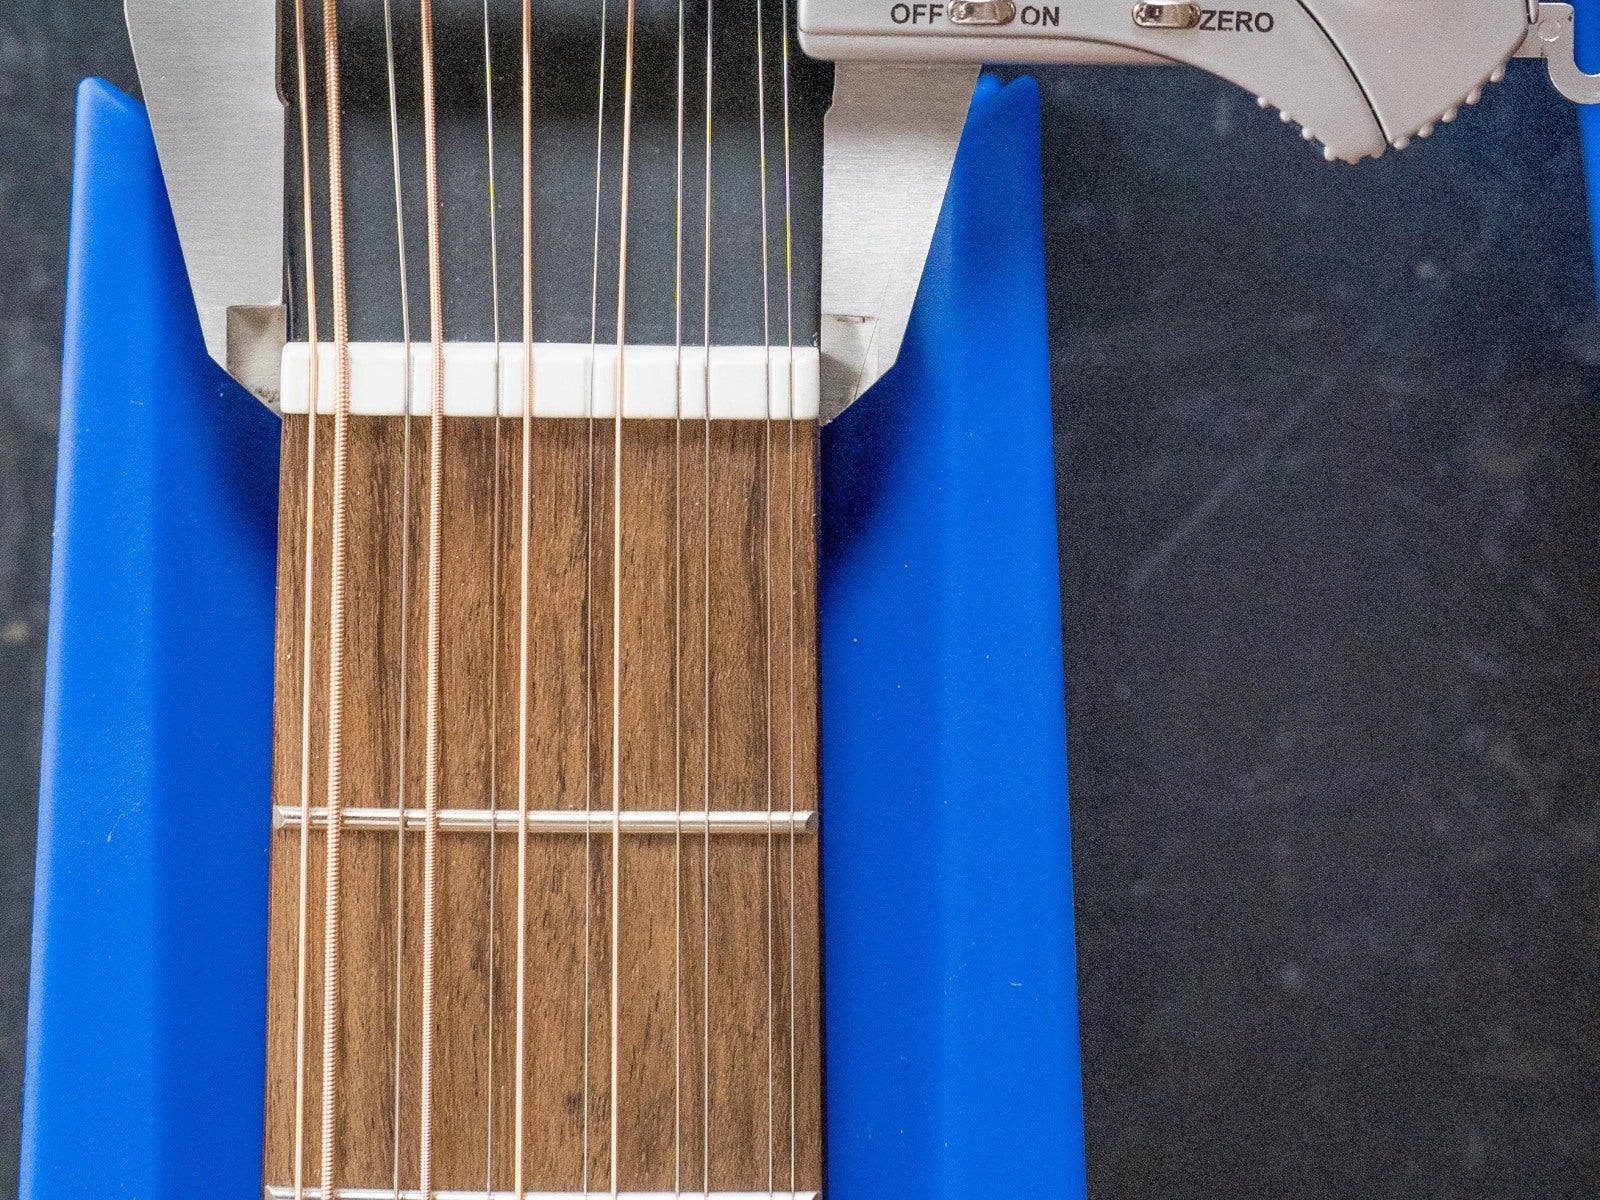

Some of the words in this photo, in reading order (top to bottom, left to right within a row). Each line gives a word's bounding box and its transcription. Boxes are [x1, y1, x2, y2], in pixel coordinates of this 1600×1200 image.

[890, 3, 944, 26] OFF
[1020, 5, 1060, 28] ON
[1200, 9, 1275, 33] ZERO
